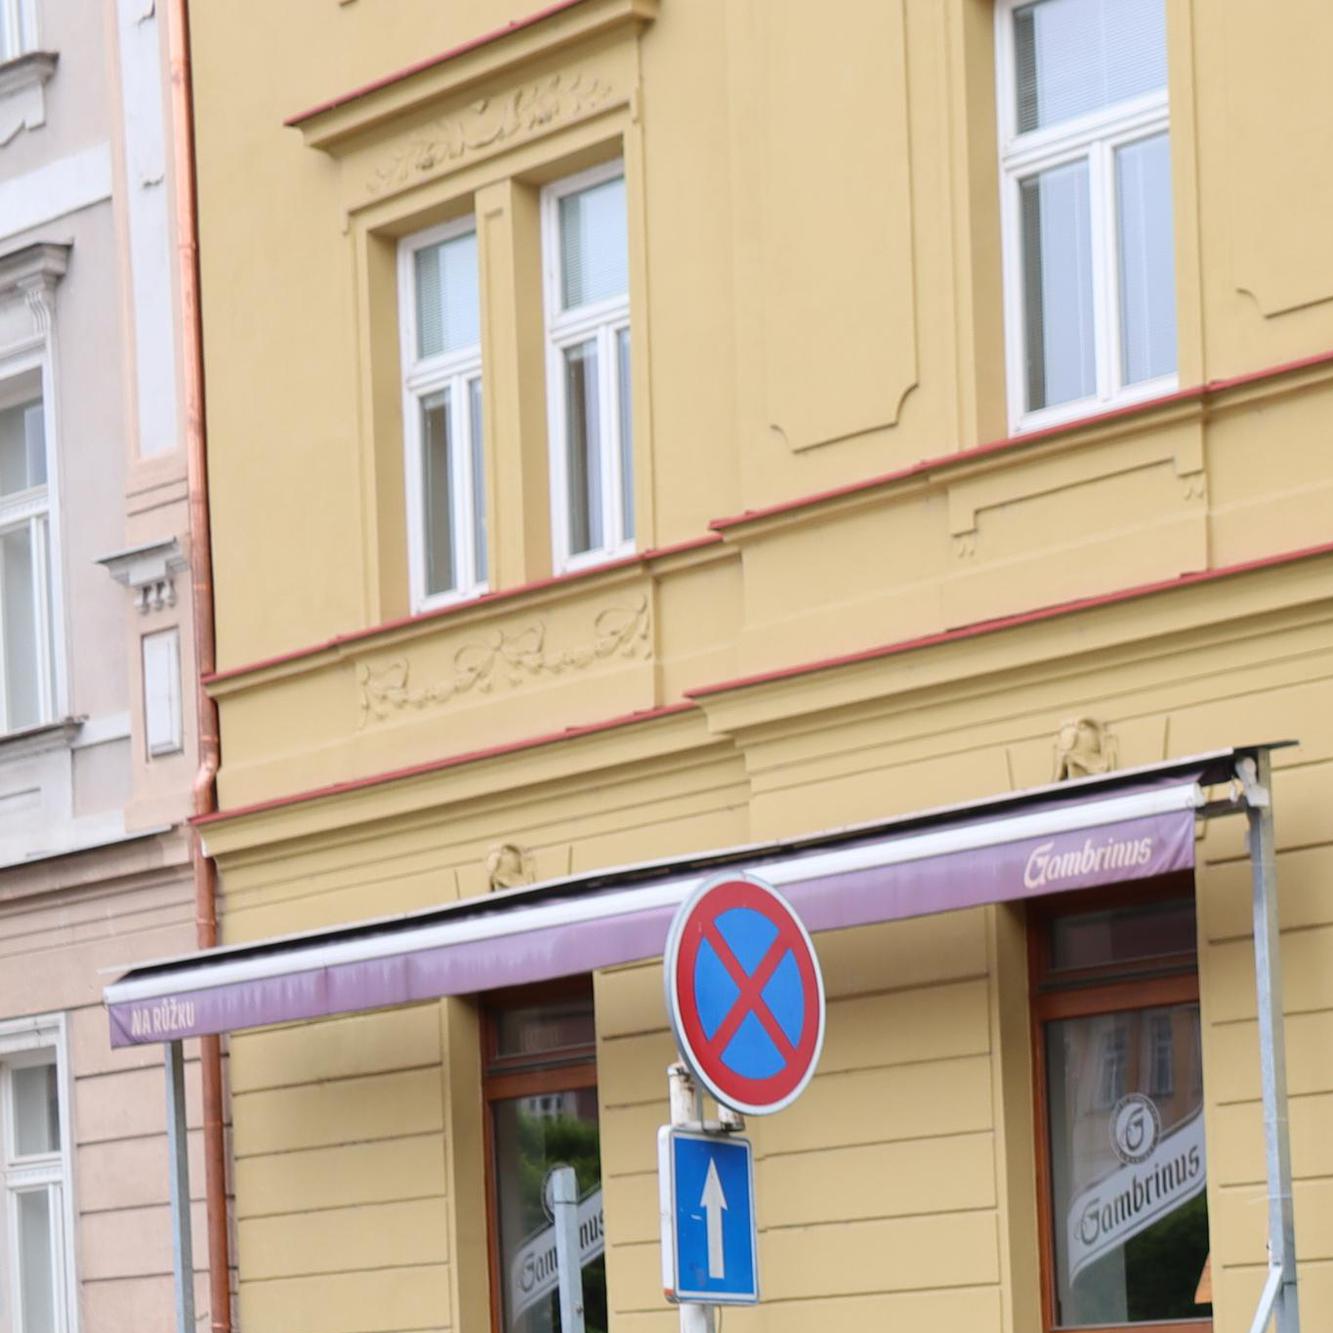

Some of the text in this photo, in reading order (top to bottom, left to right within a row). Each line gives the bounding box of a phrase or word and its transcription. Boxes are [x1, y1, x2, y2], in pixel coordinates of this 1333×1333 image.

[1023, 837, 1153, 889] Gambrinus
[131, 997, 194, 1036] NA RŮŽKU
[1076, 1145, 1200, 1245] Gambrinus
